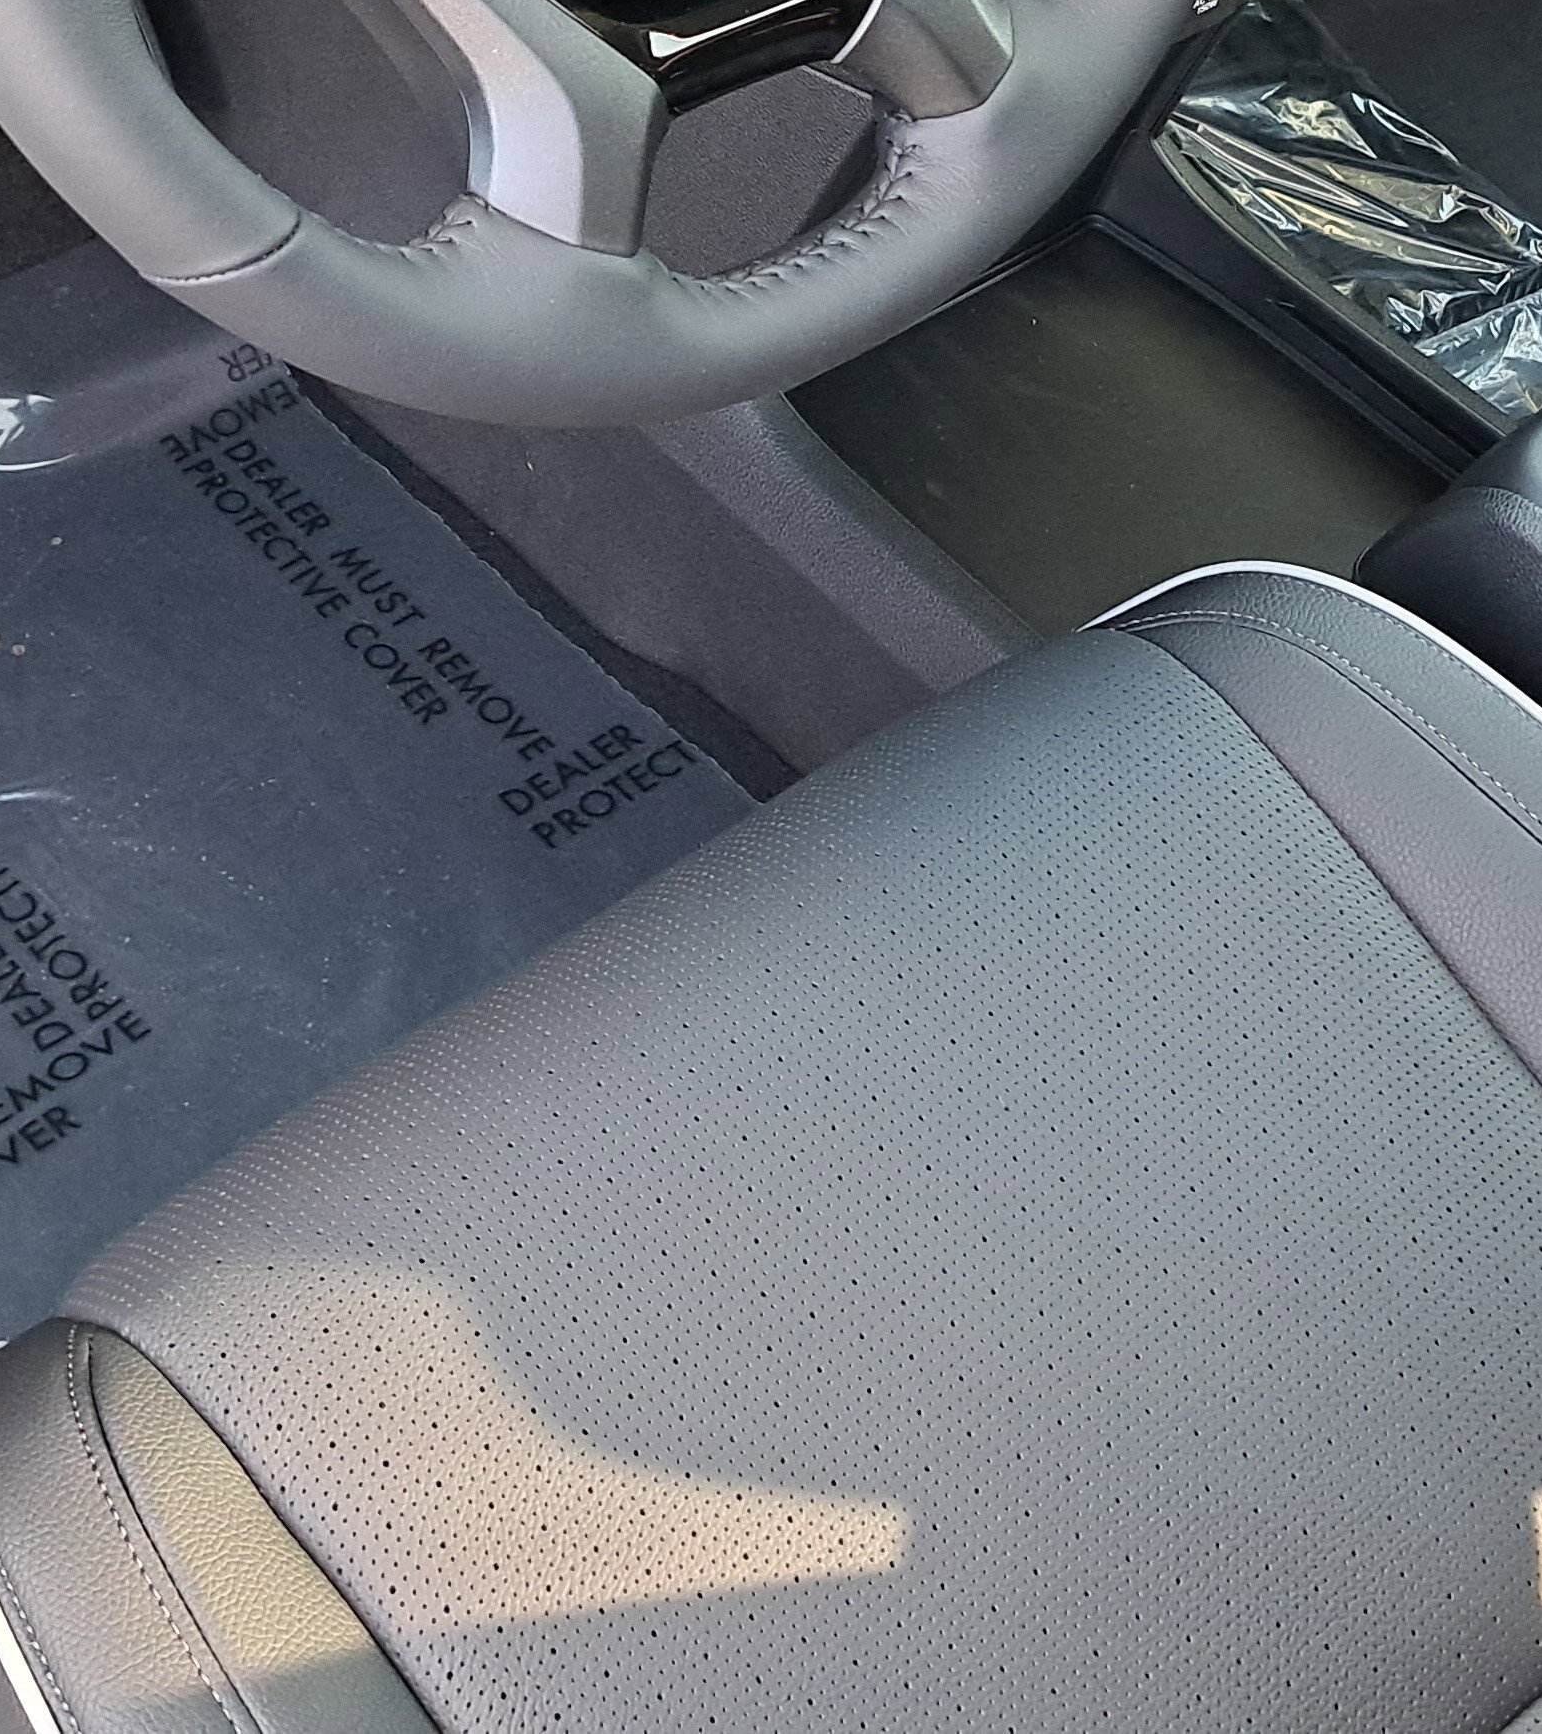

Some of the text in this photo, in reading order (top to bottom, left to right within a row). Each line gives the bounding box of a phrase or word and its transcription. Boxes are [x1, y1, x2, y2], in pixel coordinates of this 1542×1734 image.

[181, 458, 448, 726] PROTECTIVE COVER
[223, 439, 556, 763] DEALER MUST REMOVE
[498, 723, 644, 816] DEALER
